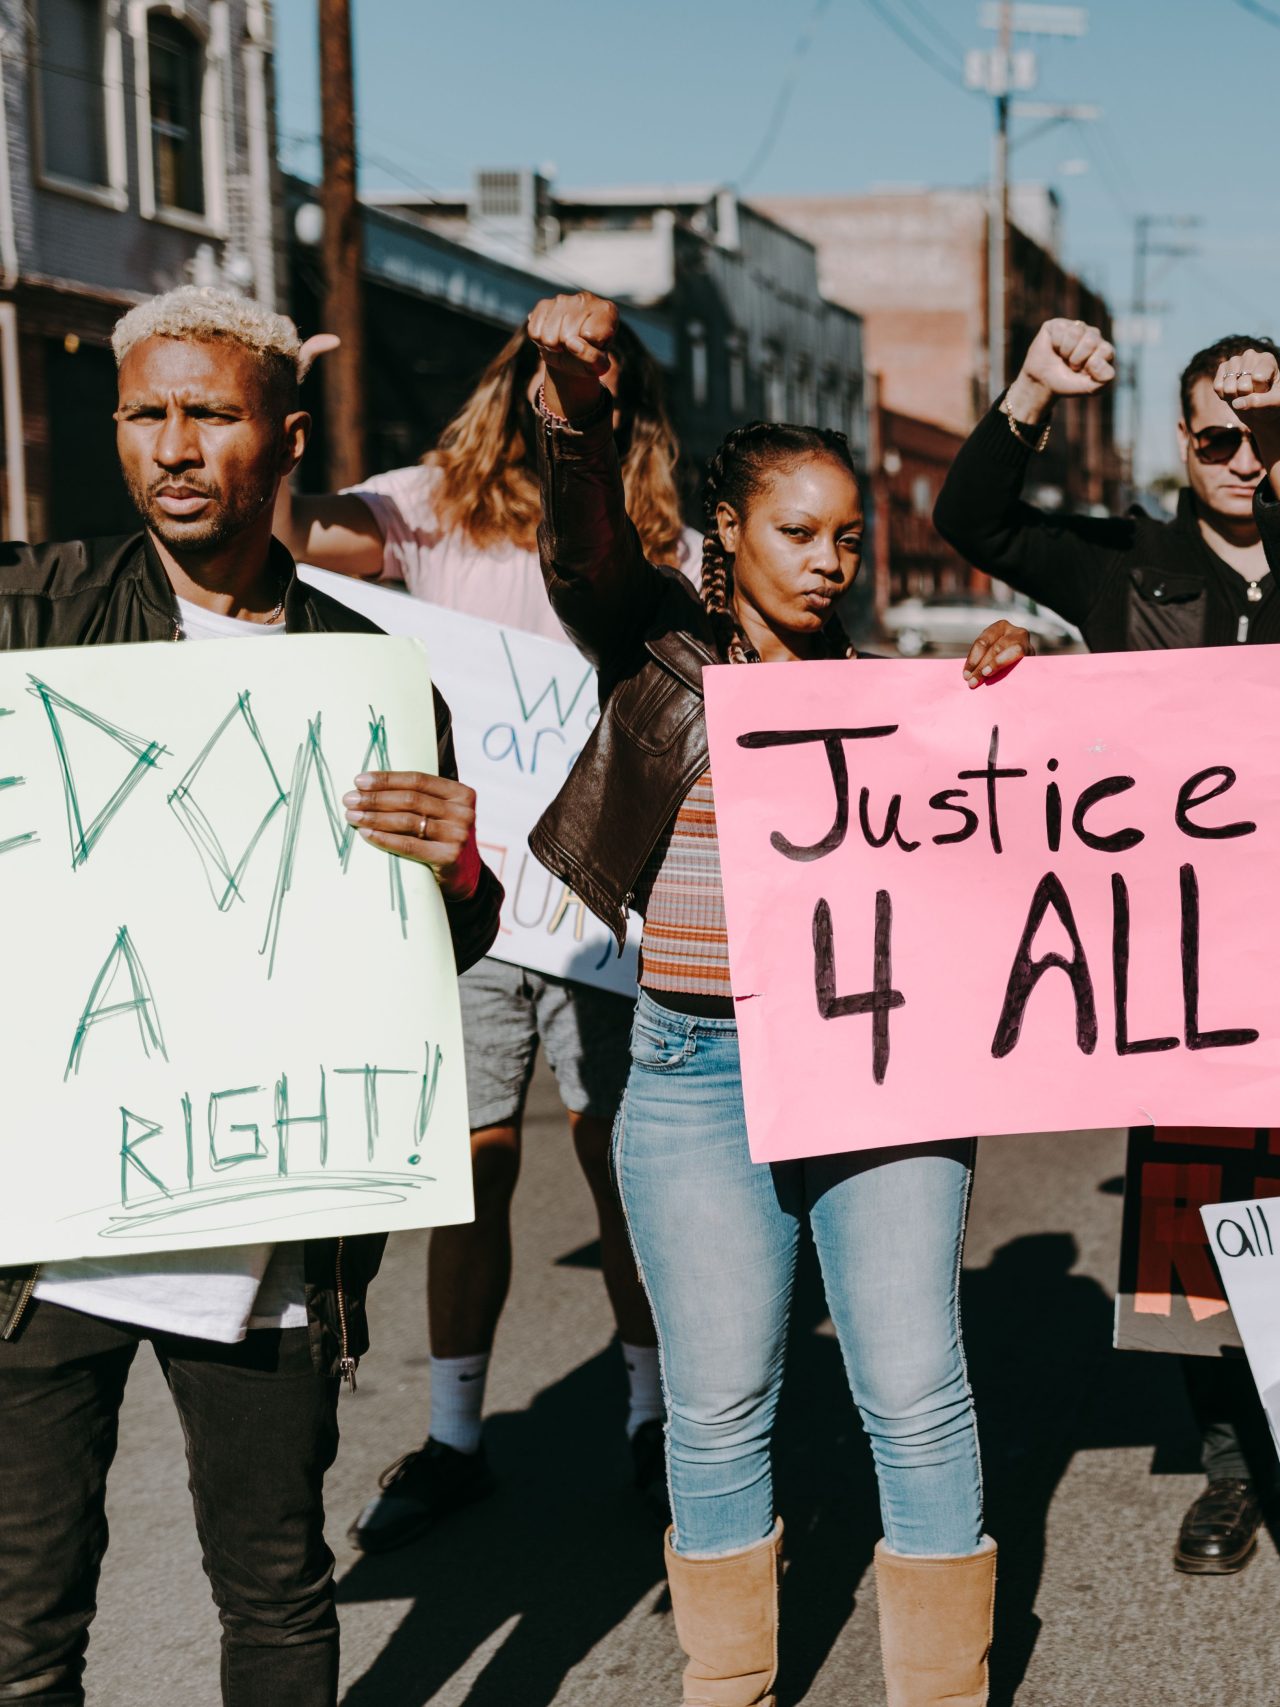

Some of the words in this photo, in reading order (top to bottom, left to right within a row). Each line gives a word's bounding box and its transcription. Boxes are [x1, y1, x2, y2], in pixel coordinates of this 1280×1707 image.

[0, 673, 408, 980] DOM
[483, 722, 580, 775] ar
[736, 724, 1257, 862] Justice
[63, 925, 169, 1082] A
[812, 889, 906, 1086] 4
[990, 863, 1260, 1059] ALL
[119, 1041, 443, 1210] RIGHT!
[1216, 1205, 1274, 1257] all
